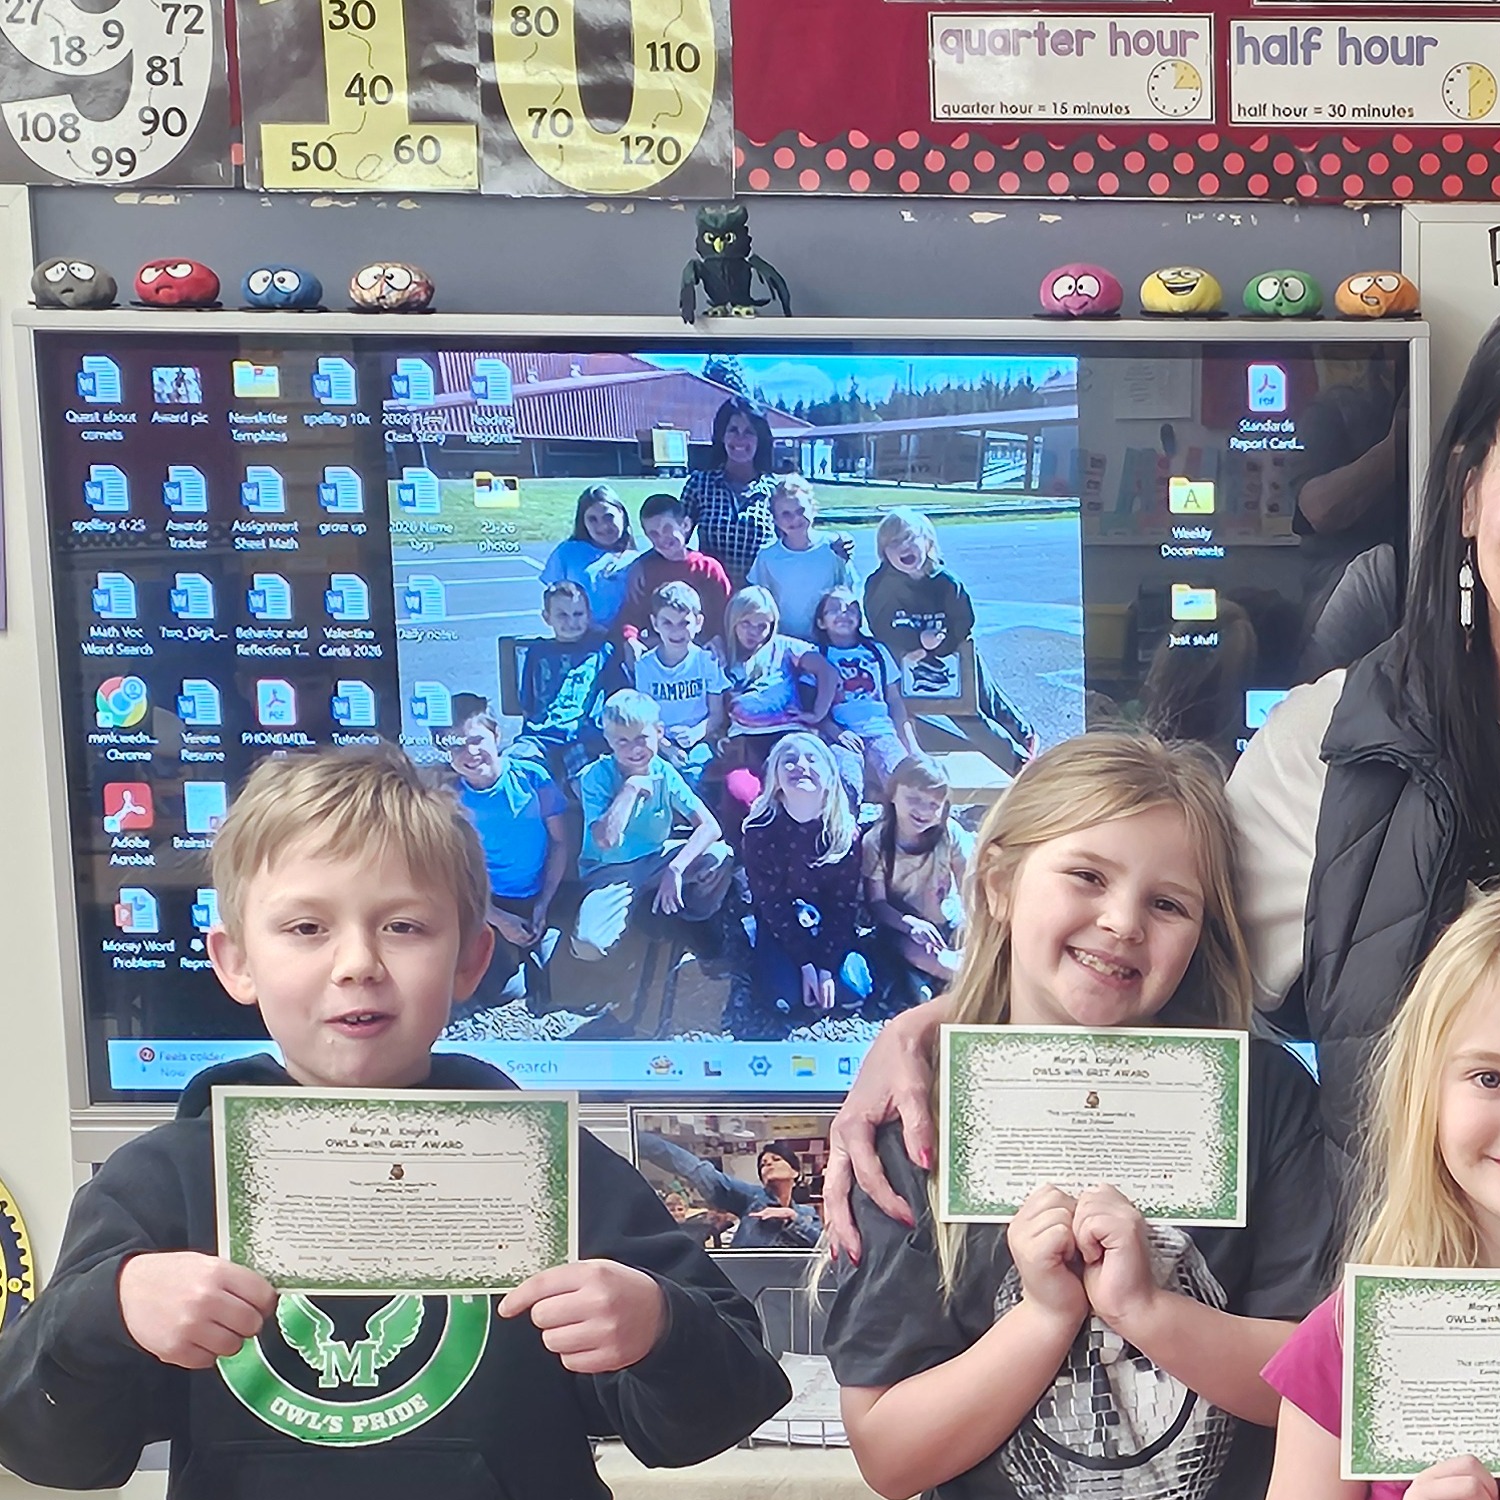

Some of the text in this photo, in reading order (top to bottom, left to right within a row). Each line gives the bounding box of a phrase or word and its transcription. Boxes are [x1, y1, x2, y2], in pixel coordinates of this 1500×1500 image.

[6, 0, 43, 25] 27
[162, 3, 204, 35] 72
[327, 0, 376, 31] 30
[509, 5, 558, 38] 80
[102, 19, 124, 50] 9
[940, 22, 1199, 63] quarter hour
[1236, 25, 1438, 67] half hour
[50, 36, 87, 67] 18
[646, 40, 700, 74] 110
[146, 56, 183, 86] 81
[344, 72, 393, 106] 40
[138, 106, 187, 137] 90
[527, 107, 574, 138] 70
[940, 101, 995, 119] quarter
[999, 101, 1034, 115] hour
[1051, 101, 1068, 115] 15
[1072, 102, 1131, 117] minutes
[1237, 103, 1264, 118] half
[1272, 103, 1309, 118] hour
[1327, 104, 1347, 118] 30
[1352, 104, 1414, 119] minutes
[18, 111, 81, 143] 108
[91, 146, 136, 178] 99
[291, 140, 338, 172] 50
[393, 133, 441, 164] 60
[620, 134, 682, 167] 120
[1161, 544, 1224, 558] Documents
[1168, 633, 1193, 648] Just
[111, 835, 150, 850] Adobe
[110, 853, 156, 867] Acrobat
[505, 1057, 559, 1074] Search
[325, 1138, 359, 1149] OWLS
[388, 1140, 417, 1149] GRIT
[421, 1140, 464, 1150] AWARD
[1445, 1315, 1477, 1324] OWLS
[319, 1340, 380, 1389] M
[269, 1392, 429, 1434] OWL'S PRIDE
